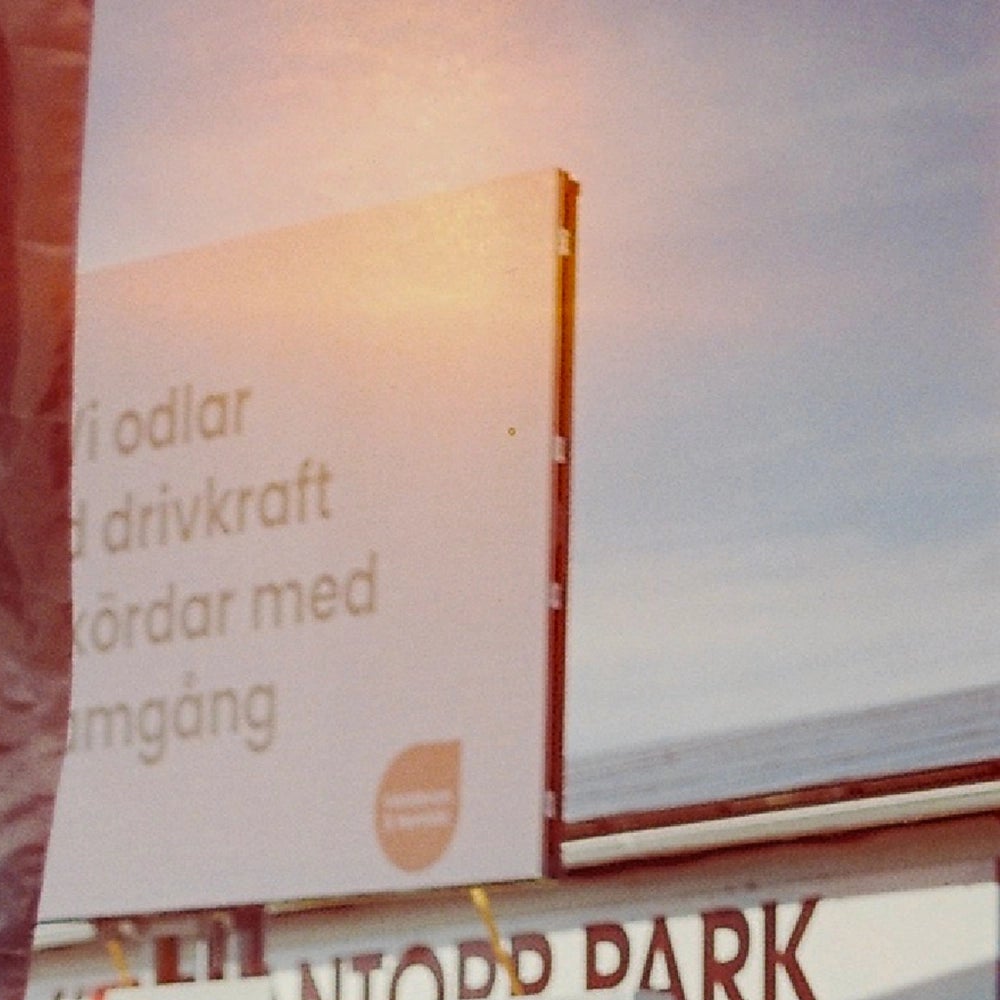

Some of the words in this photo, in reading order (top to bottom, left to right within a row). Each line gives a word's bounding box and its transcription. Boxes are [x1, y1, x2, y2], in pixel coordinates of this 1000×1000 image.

[114, 384, 252, 456] odlar
[103, 459, 332, 554] drivkraft
[252, 551, 379, 631] med
